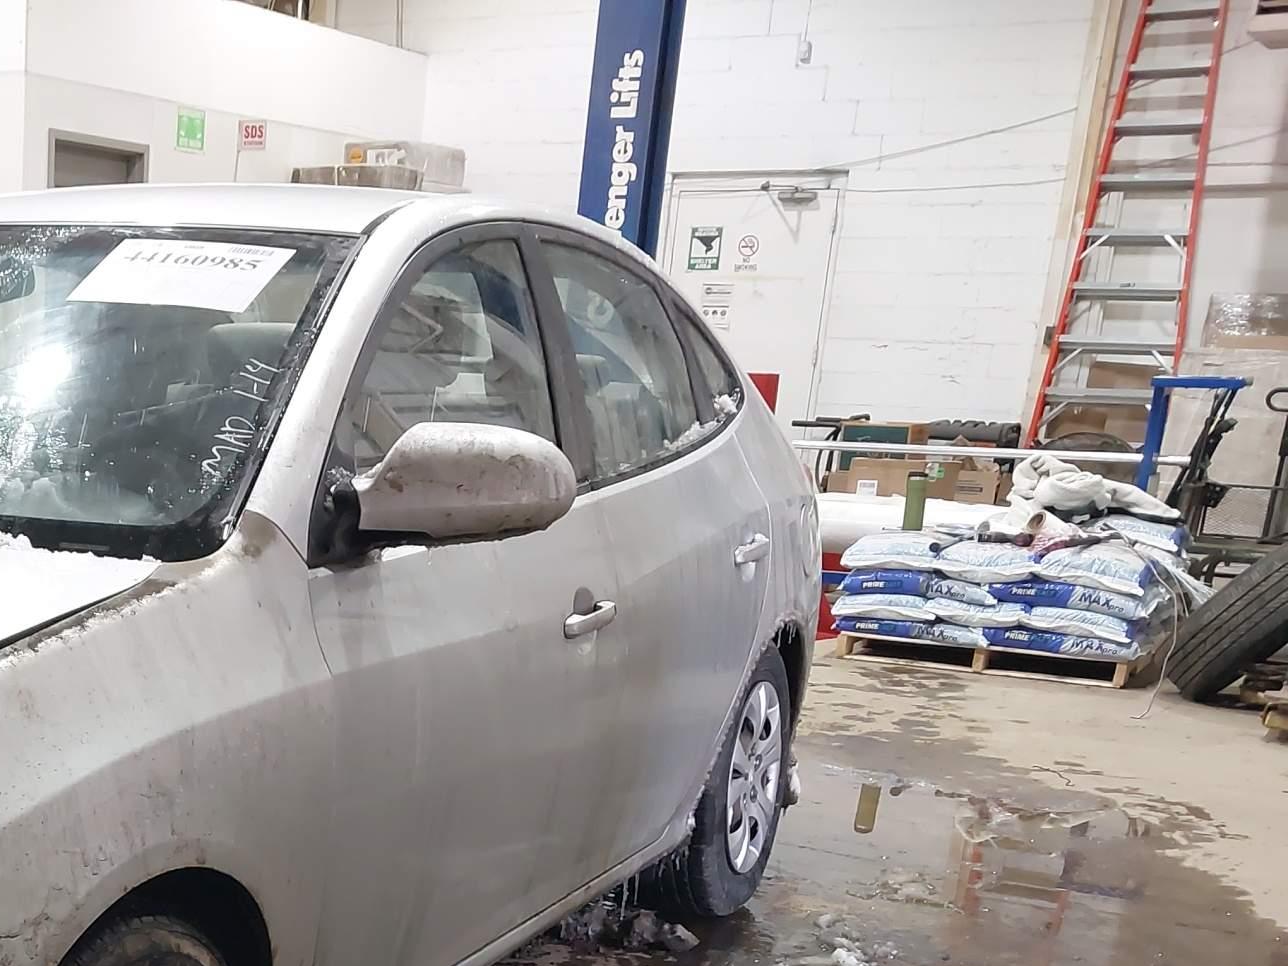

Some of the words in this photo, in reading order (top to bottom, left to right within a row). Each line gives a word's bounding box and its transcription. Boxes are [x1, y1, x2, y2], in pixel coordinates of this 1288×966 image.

[610, 49, 644, 119] Lifts
[244, 125, 264, 139] SDS
[605, 125, 637, 229] enger
[123, 250, 264, 271] 44160985
